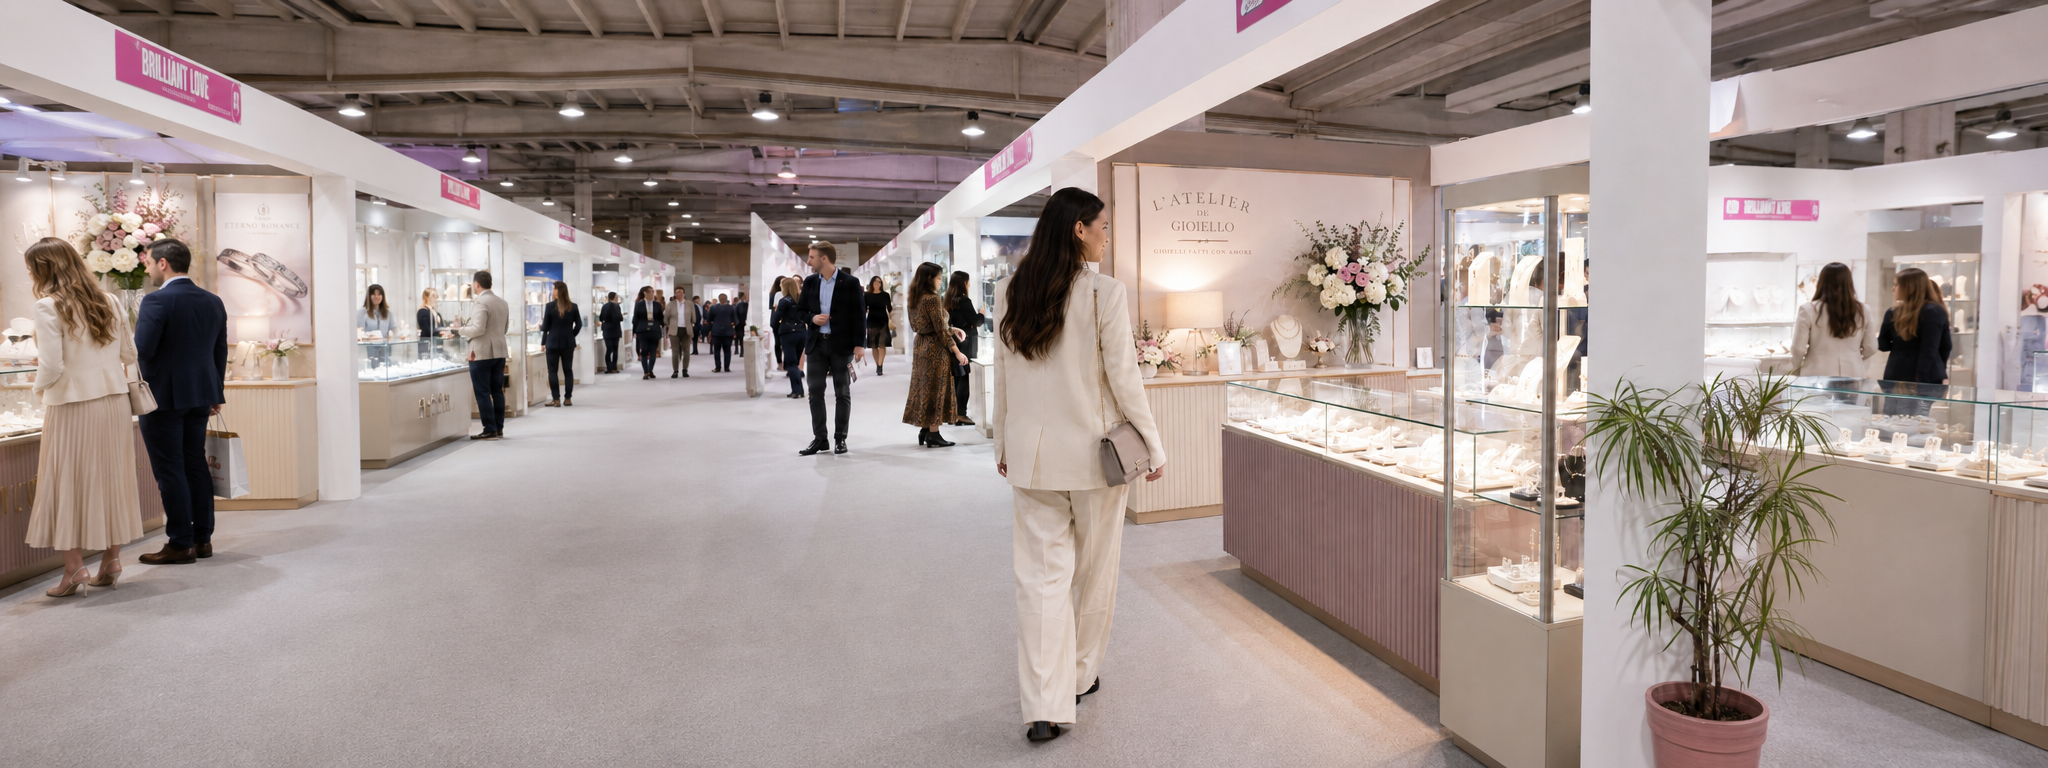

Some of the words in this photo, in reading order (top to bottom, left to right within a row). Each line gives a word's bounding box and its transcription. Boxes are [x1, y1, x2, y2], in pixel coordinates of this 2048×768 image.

[142, 47, 188, 91] BRILLIANT
[190, 68, 209, 100] LOVE
[1152, 192, 1250, 213] L'ATELIER
[1171, 220, 1235, 232] GIOIELLO
